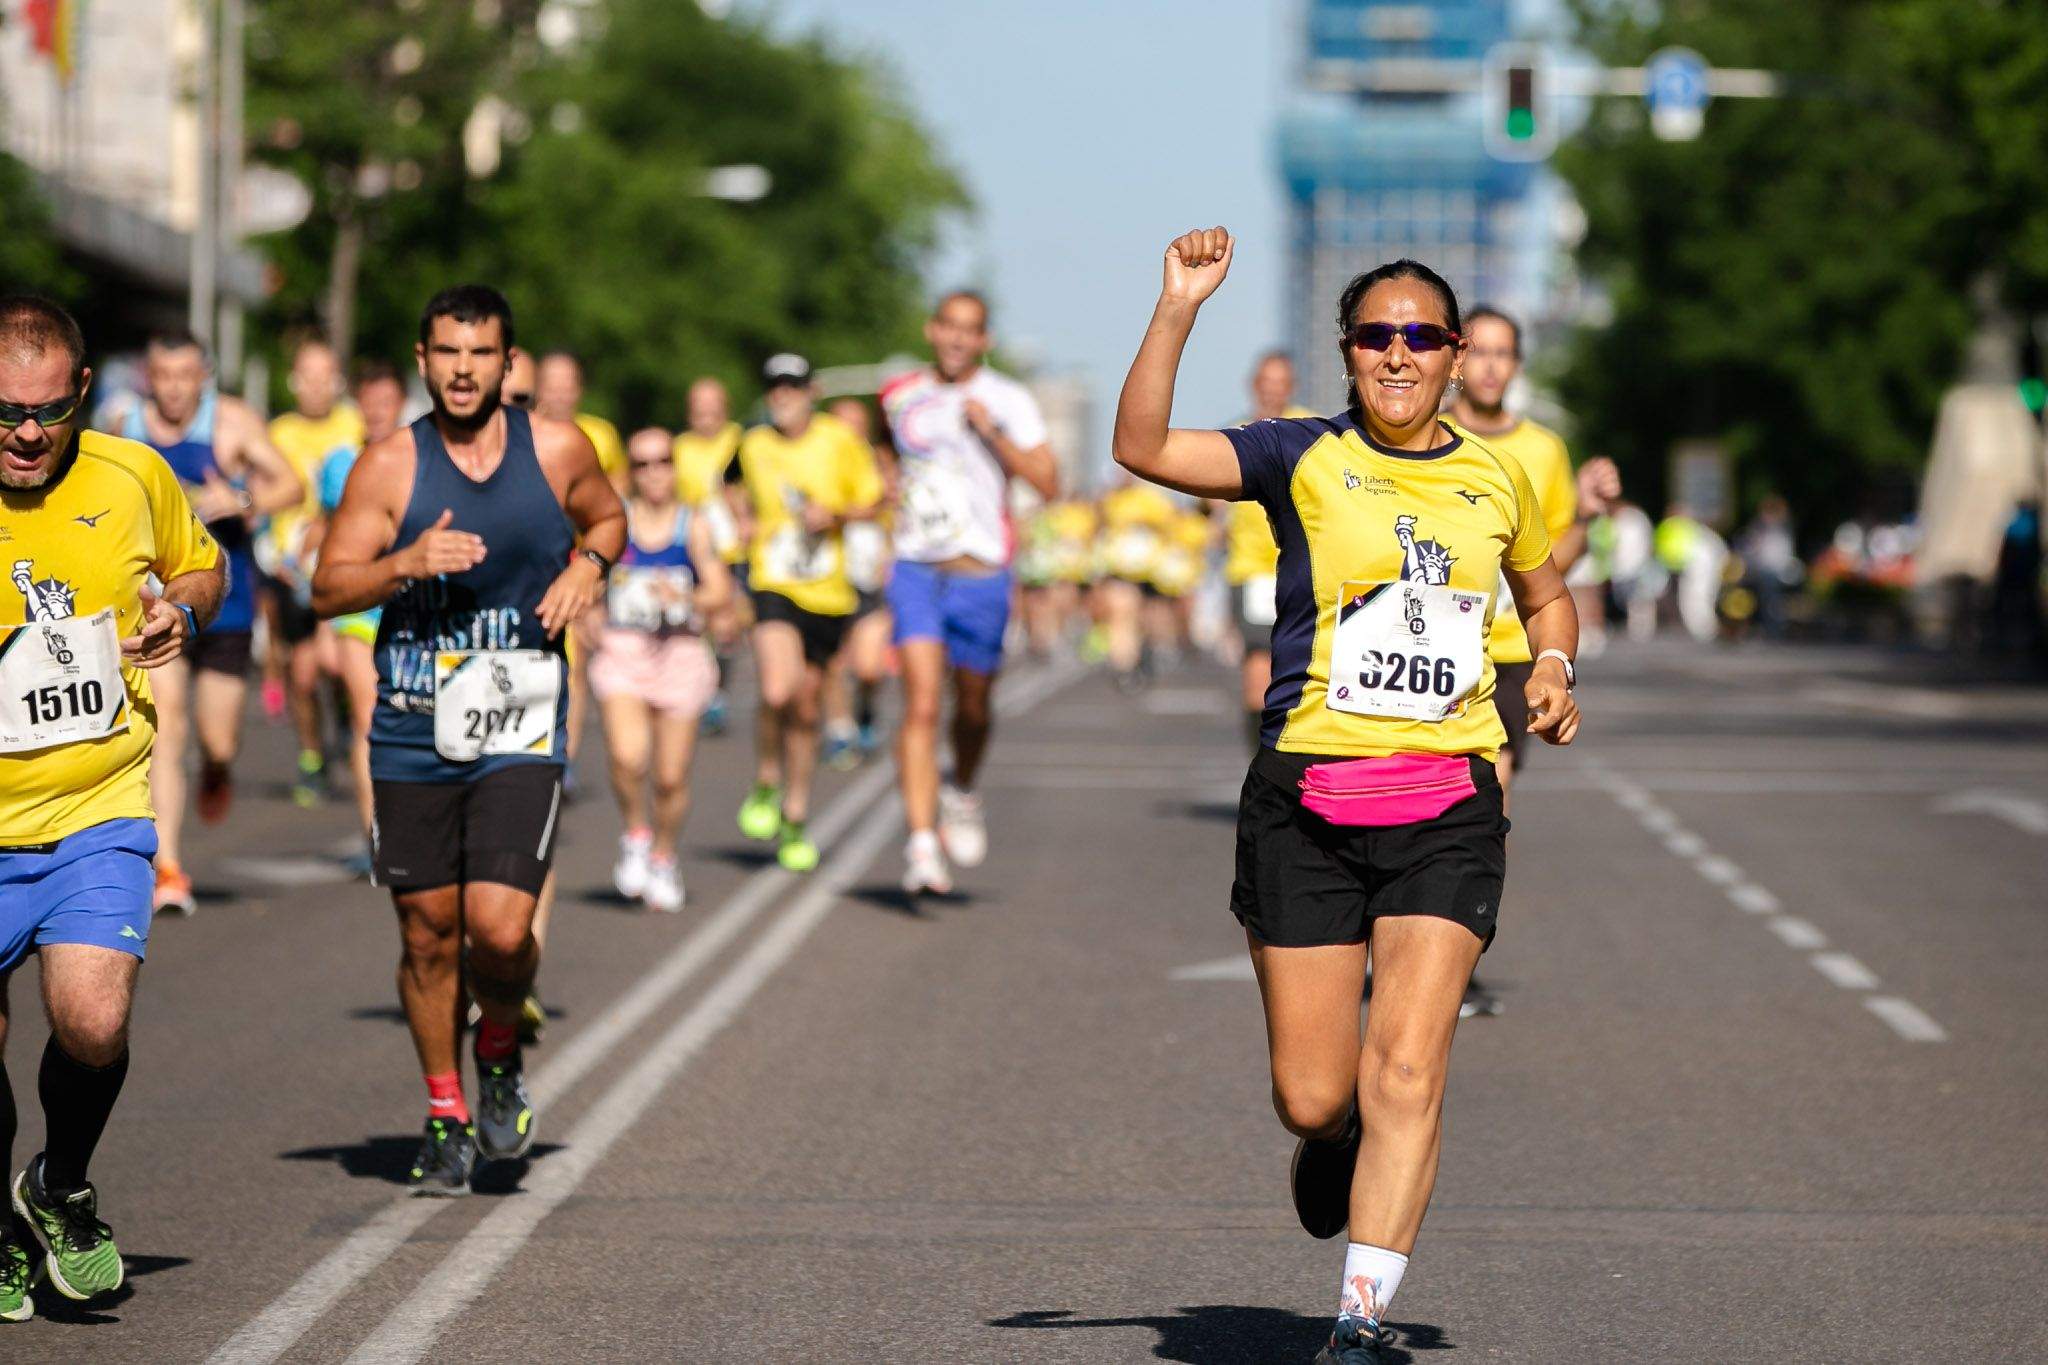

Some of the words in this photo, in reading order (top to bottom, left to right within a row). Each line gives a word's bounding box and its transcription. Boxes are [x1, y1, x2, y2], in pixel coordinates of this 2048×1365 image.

[1364, 475, 1396, 487] Liberty
[1411, 620, 1424, 632] 13
[59, 651, 71, 663] 13
[1359, 649, 1456, 697] 3266
[21, 680, 103, 725] 1510
